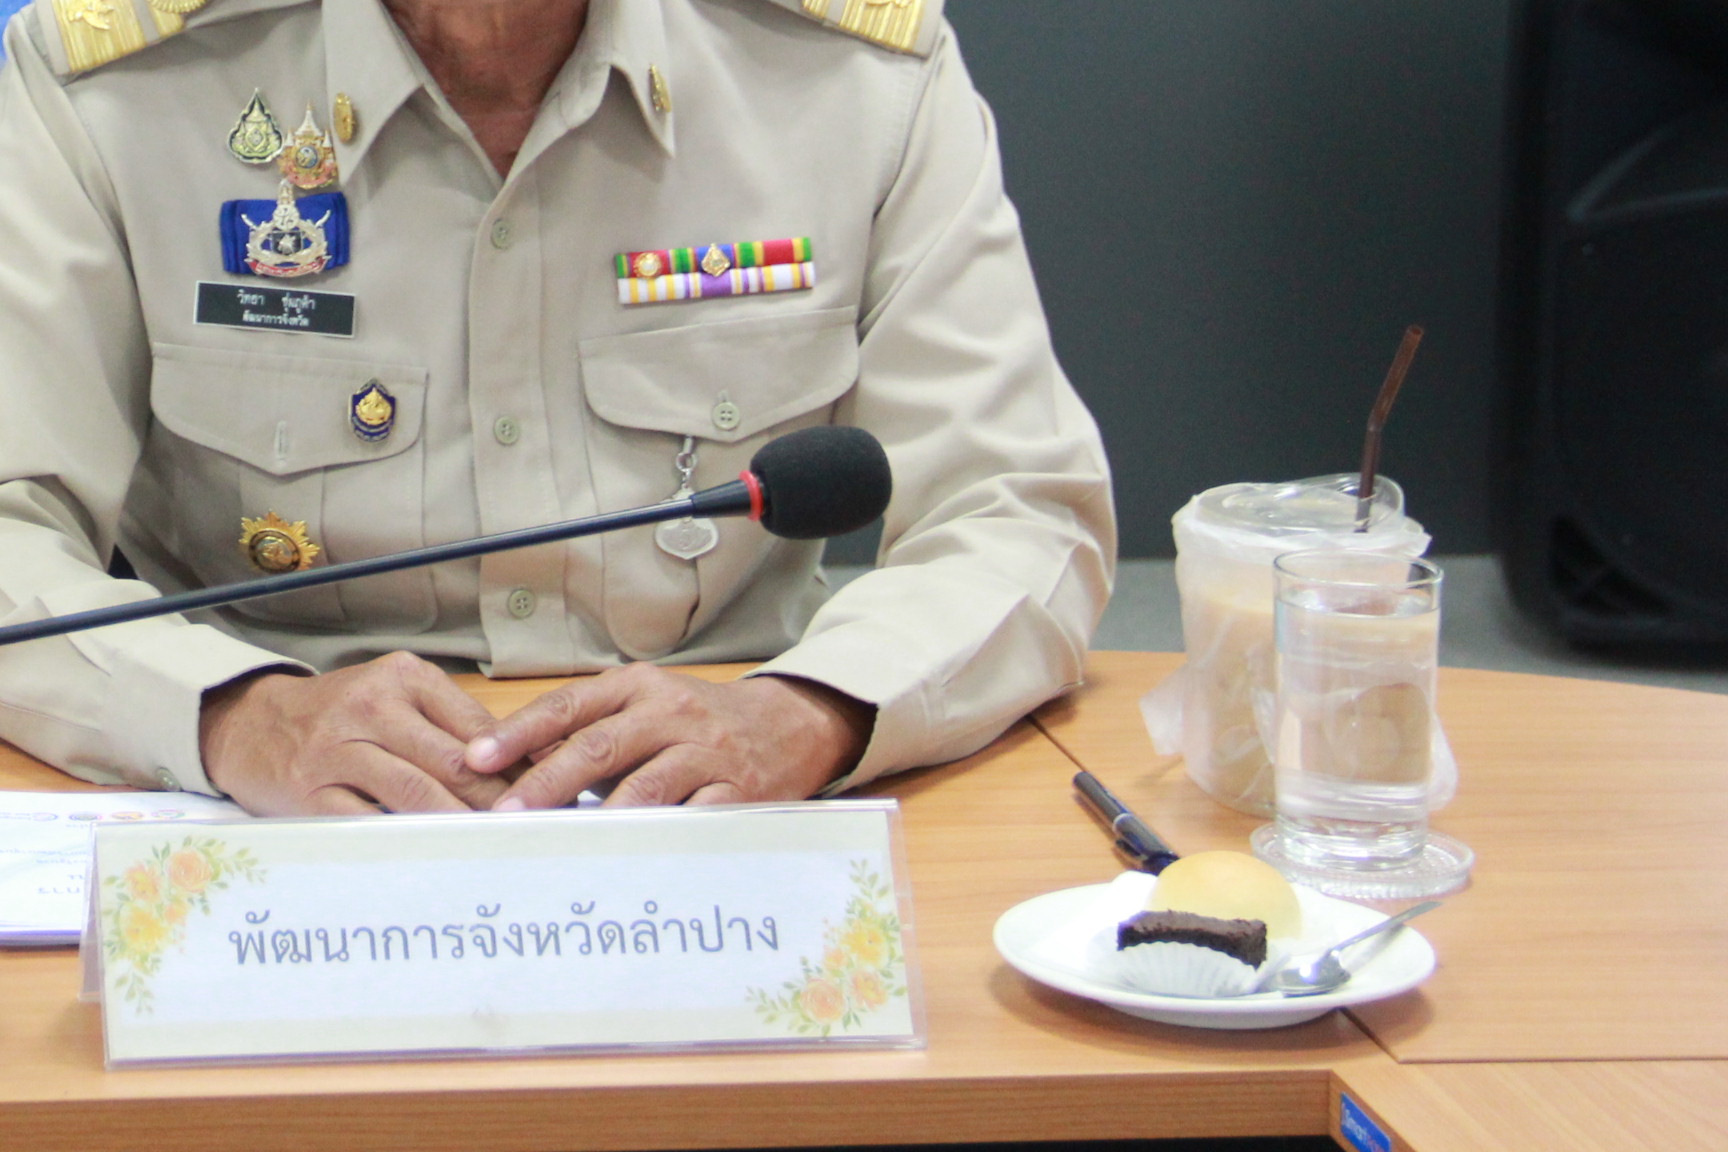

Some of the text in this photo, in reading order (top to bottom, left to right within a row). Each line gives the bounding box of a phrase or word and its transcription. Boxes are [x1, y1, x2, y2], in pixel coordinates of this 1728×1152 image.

[229, 901, 778, 964] พัฒนาการจังหวัดลำปาง
